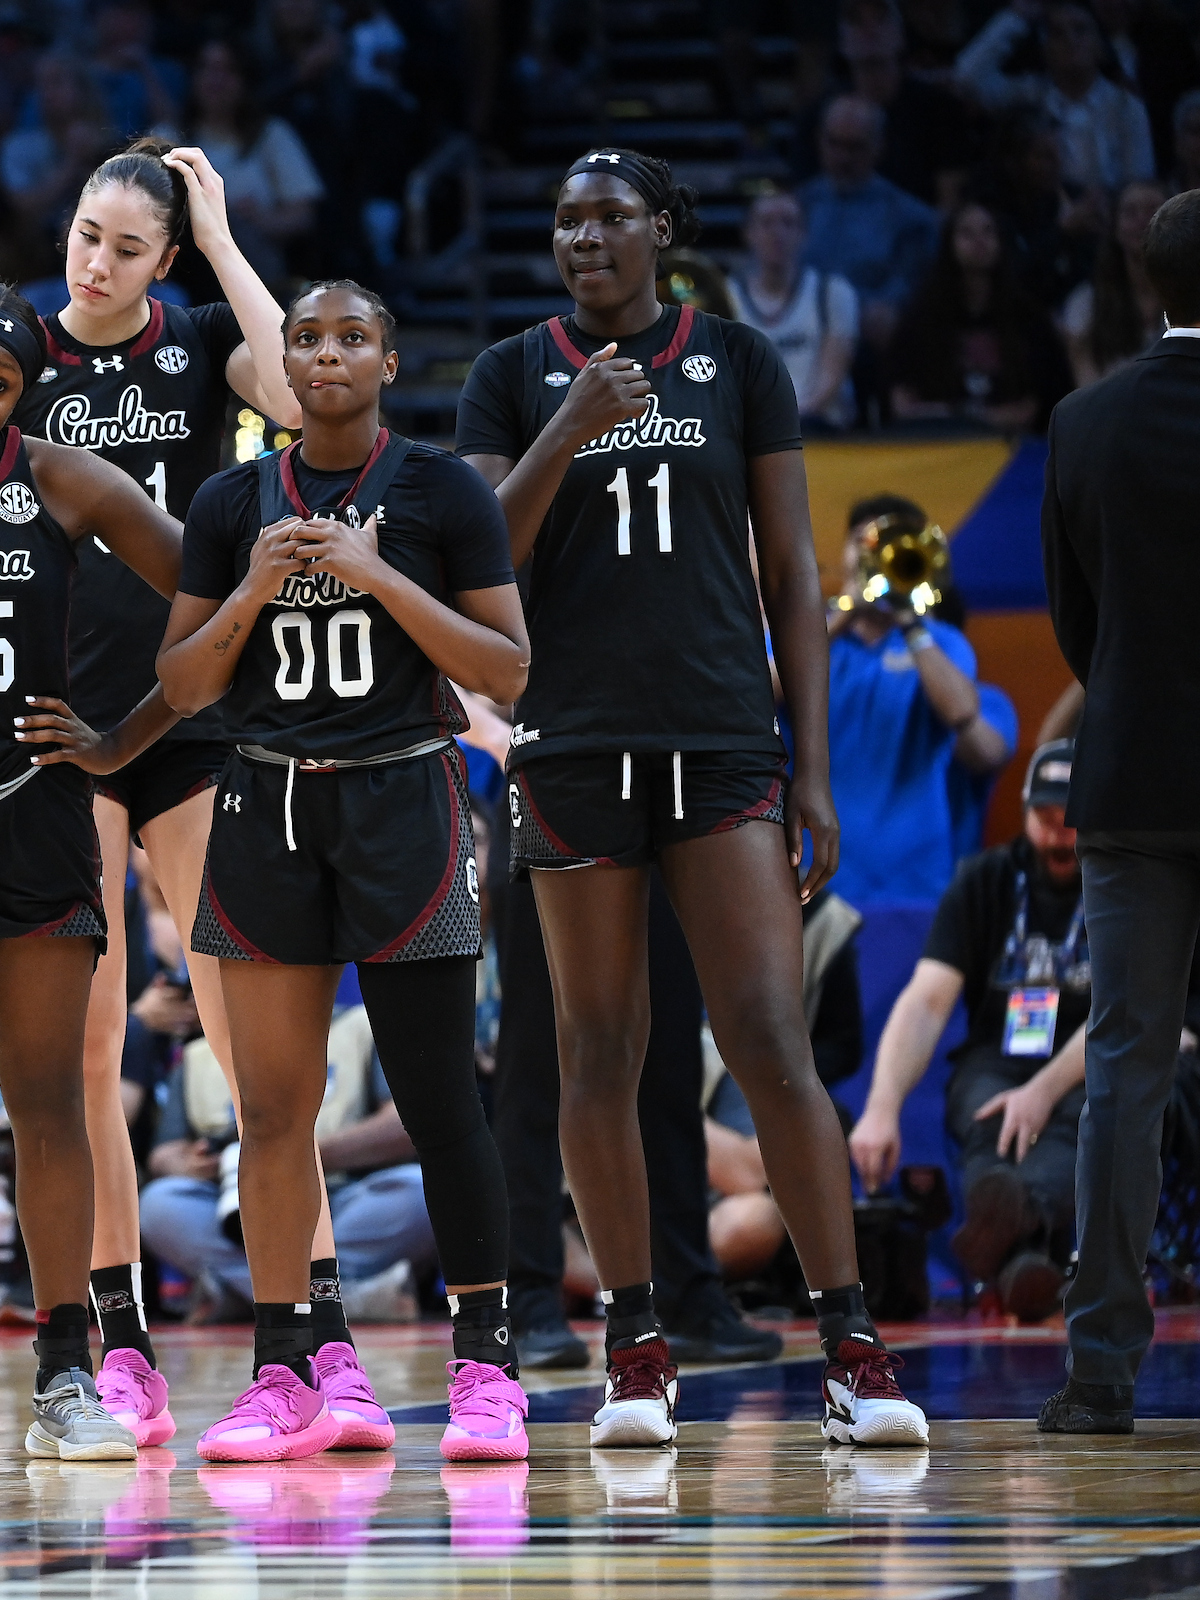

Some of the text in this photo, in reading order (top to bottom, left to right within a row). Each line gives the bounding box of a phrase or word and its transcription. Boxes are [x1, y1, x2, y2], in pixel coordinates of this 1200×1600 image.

[157, 347, 187, 372] SEC
[684, 355, 715, 381] SEC
[46, 384, 192, 450] Carolina
[573, 393, 707, 459] arolina
[1, 484, 31, 513] SEC
[606, 463, 672, 556] 11
[271, 609, 374, 700] 00
